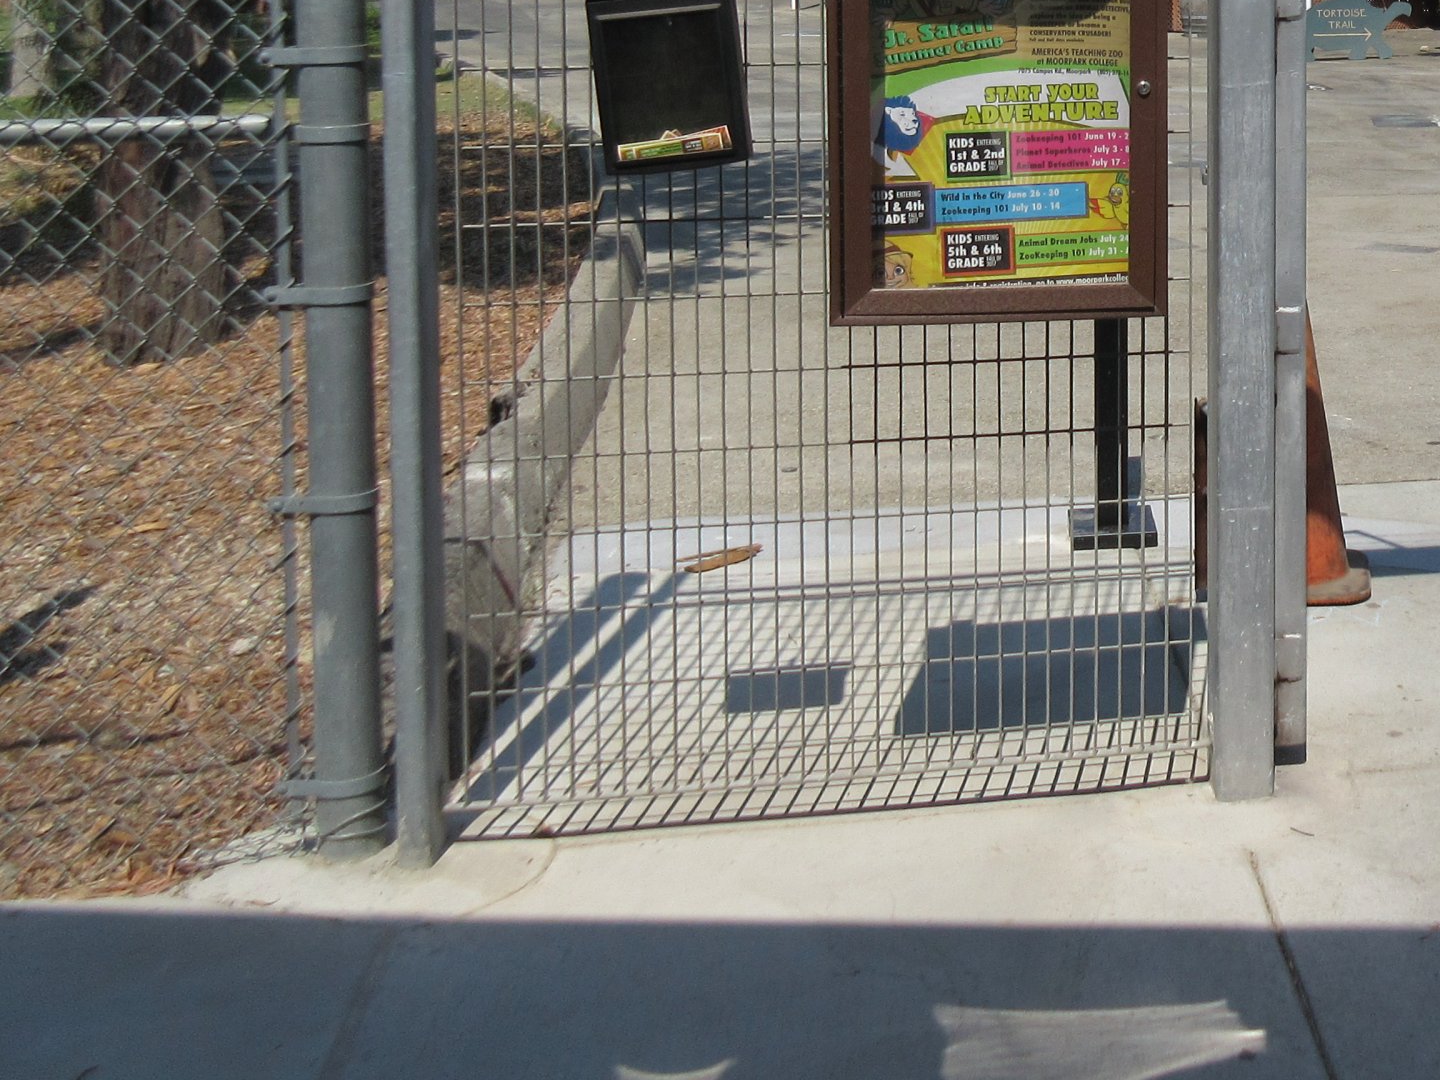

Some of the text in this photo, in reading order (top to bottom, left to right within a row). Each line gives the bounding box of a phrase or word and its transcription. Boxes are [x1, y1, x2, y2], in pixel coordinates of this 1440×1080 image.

[1316, 8, 1366, 18] TORTOISE
[1328, 20, 1356, 28] TRAIL
[884, 28, 913, 48] Jr.
[881, 35, 1004, 66] ummer Camp
[1032, 48, 1123, 58] AMERICA'S TEACHING ZOO
[1046, 58, 1086, 66] MOORPARK
[1089, 58, 1118, 66] COLLEGE
[984, 82, 1099, 103] START YOUR
[963, 101, 1118, 125] ADVENTURE
[949, 138, 1001, 148] KIDS ENTERING
[1016, 134, 1064, 144] Zookeeping
[1068, 133, 1081, 141] 101
[1084, 132, 1104, 140] June
[1108, 132, 1116, 140] 19
[950, 148, 1005, 160] 1st & 2nd
[1016, 148, 1042, 156] Planet
[1094, 145, 1110, 154] July
[950, 161, 986, 173] GRADE
[1016, 161, 1045, 169] Animal
[1048, 160, 1088, 168] Detectives
[1092, 158, 1108, 168] July
[1111, 158, 1120, 166] 17
[896, 190, 921, 198] ENTERING
[941, 193, 959, 201] Wild
[973, 192, 987, 200] the
[990, 191, 1005, 200] City
[1008, 191, 1026, 199] June
[1049, 188, 1059, 196] 30
[893, 201, 901, 211] &
[905, 200, 924, 211] 4th
[942, 206, 991, 215] Zookeeping
[995, 204, 1008, 212] 101
[1012, 203, 1028, 212] July
[1050, 202, 1060, 210] 14
[948, 233, 999, 244] KIDS ENTERING
[1019, 238, 1047, 247] Animal
[1050, 237, 1077, 245] Dream
[1079, 235, 1098, 244] Jobs
[1100, 234, 1117, 244] July
[948, 243, 1002, 256] 5th & 6th
[1020, 250, 1068, 260] ZooKeeping
[1088, 247, 1105, 257] July
[948, 256, 984, 268] GRADE
